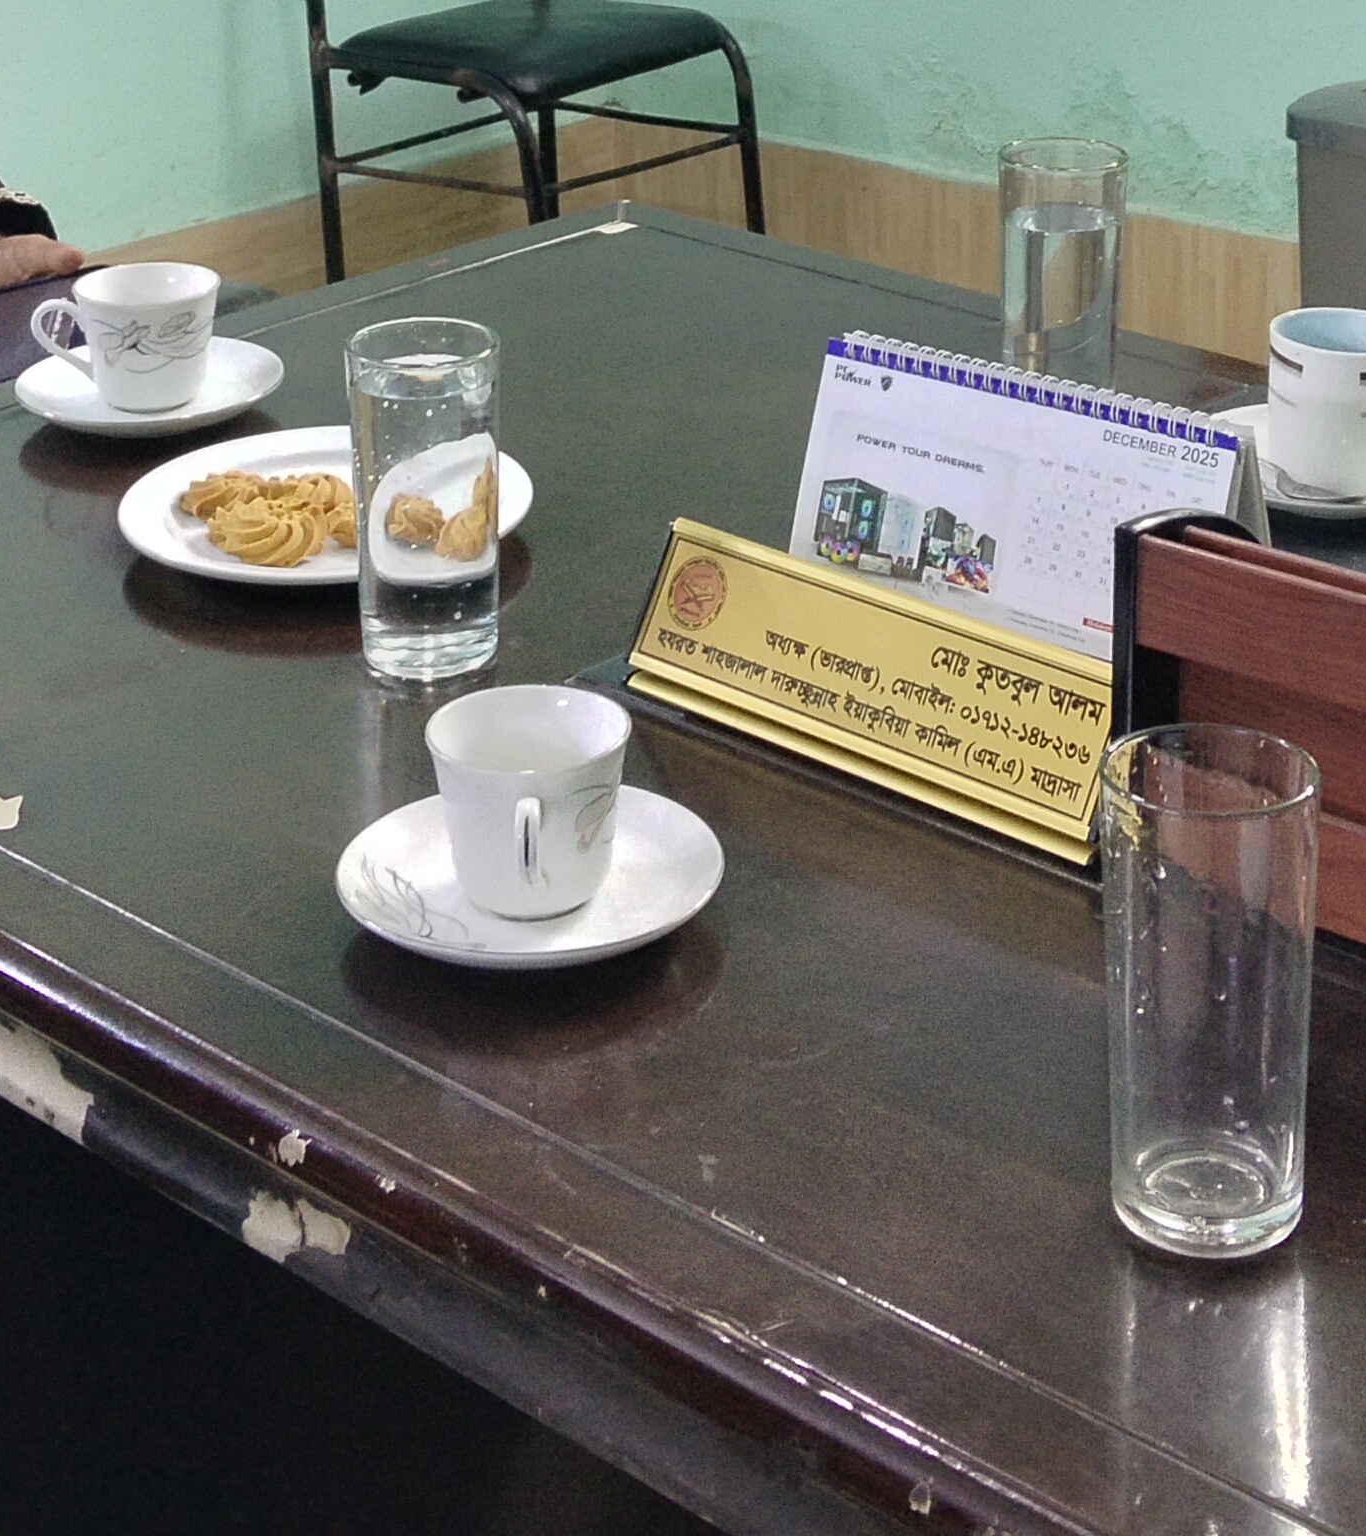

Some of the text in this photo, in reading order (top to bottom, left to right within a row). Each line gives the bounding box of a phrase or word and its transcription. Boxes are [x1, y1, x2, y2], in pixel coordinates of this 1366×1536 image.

[835, 370, 871, 387] POWER
[856, 434, 896, 451] POWER
[902, 445, 931, 460] YOUR
[1103, 429, 1177, 458] DECEMBER
[1181, 445, 1220, 469] 2025
[657, 627, 699, 656] হযরত
[701, 643, 768, 683] শাহজালাল
[843, 690, 912, 738] ইয়াকুবিয়া
[915, 722, 962, 756] কামিল
[963, 740, 1024, 784] (এম.এ)
[1031, 766, 1083, 802] মাদ্রাসা
[765, 629, 809, 659] অধ্যক্ষ
[961, 705, 1091, 765] ০১৭১২-১৪৮২৩৬
[931, 645, 1106, 726] মোঃ কুতবুল আলম
